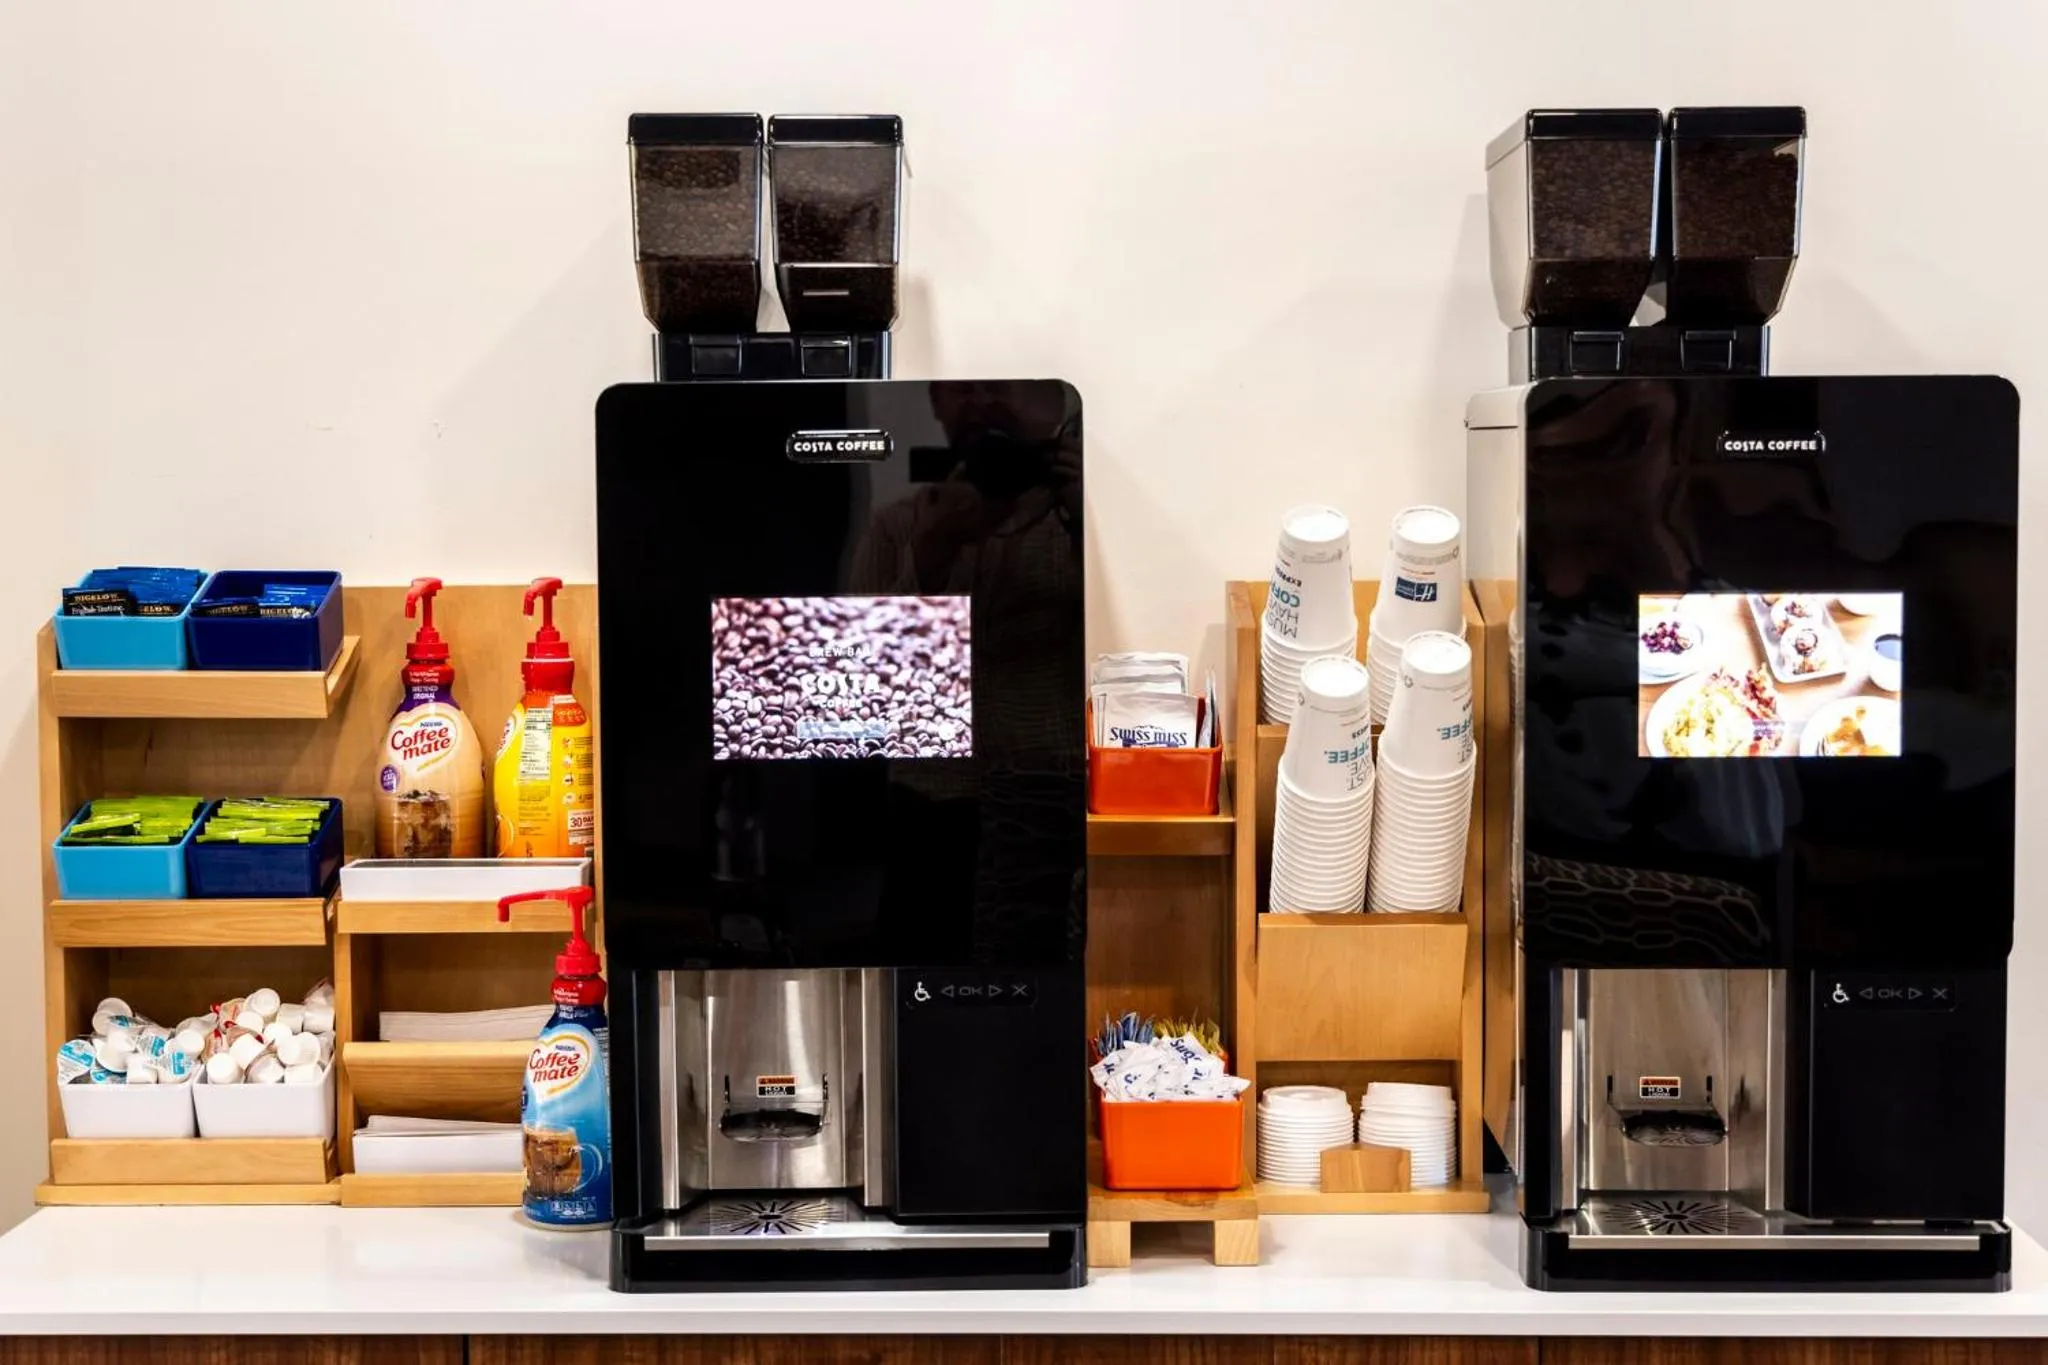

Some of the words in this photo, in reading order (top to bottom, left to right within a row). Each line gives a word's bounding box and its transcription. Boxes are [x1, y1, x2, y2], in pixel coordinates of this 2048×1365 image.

[793, 441, 833, 453] COSTA
[836, 440, 885, 451] COFFEE
[1724, 440, 1764, 452] COSTA
[1767, 440, 1817, 450] COFFEE
[391, 727, 449, 751] Coffee
[403, 737, 450, 761] mate
[570, 817, 583, 828] 30
[529, 1048, 581, 1070] Coffee
[533, 1064, 579, 1083] mate
